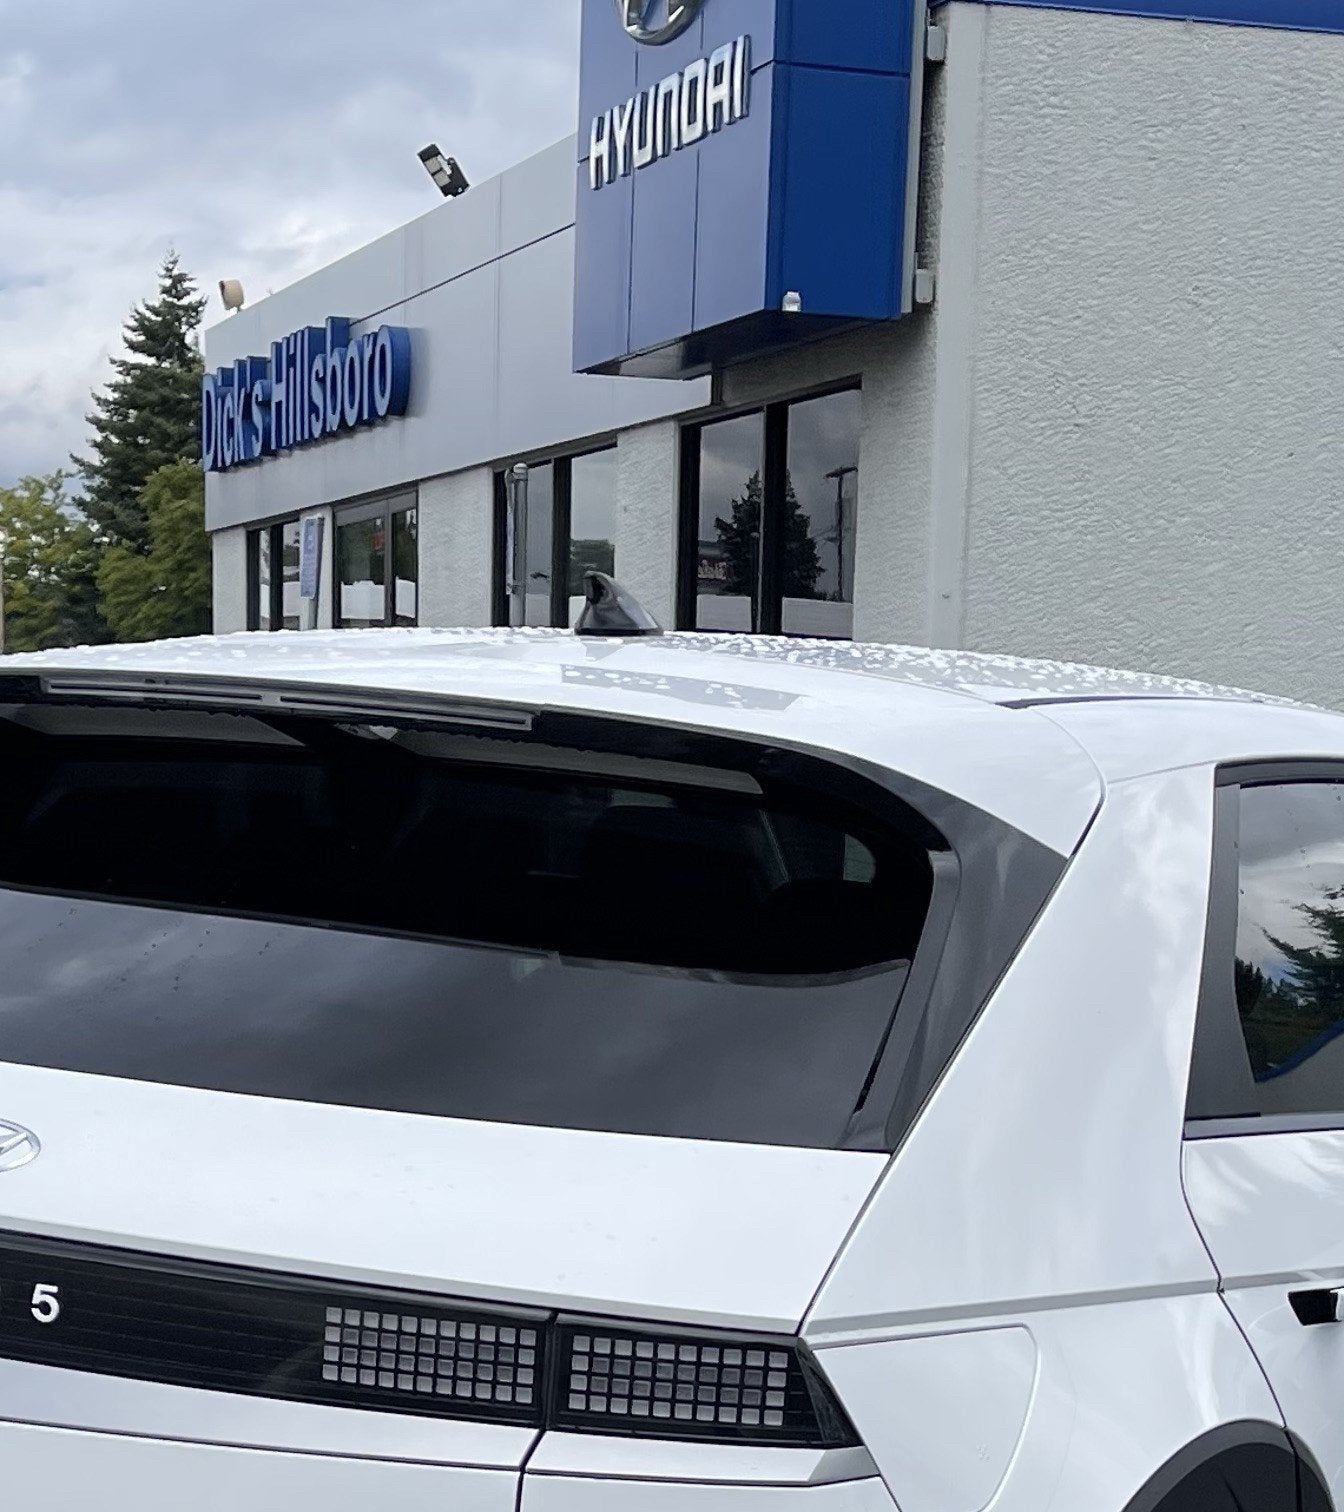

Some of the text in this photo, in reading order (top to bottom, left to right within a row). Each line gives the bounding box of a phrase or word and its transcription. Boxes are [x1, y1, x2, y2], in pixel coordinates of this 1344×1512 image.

[590, 34, 751, 191] HYUNDAI
[202, 316, 398, 472] Dick's Hillsboro
[30, 1283, 60, 1323] 5
